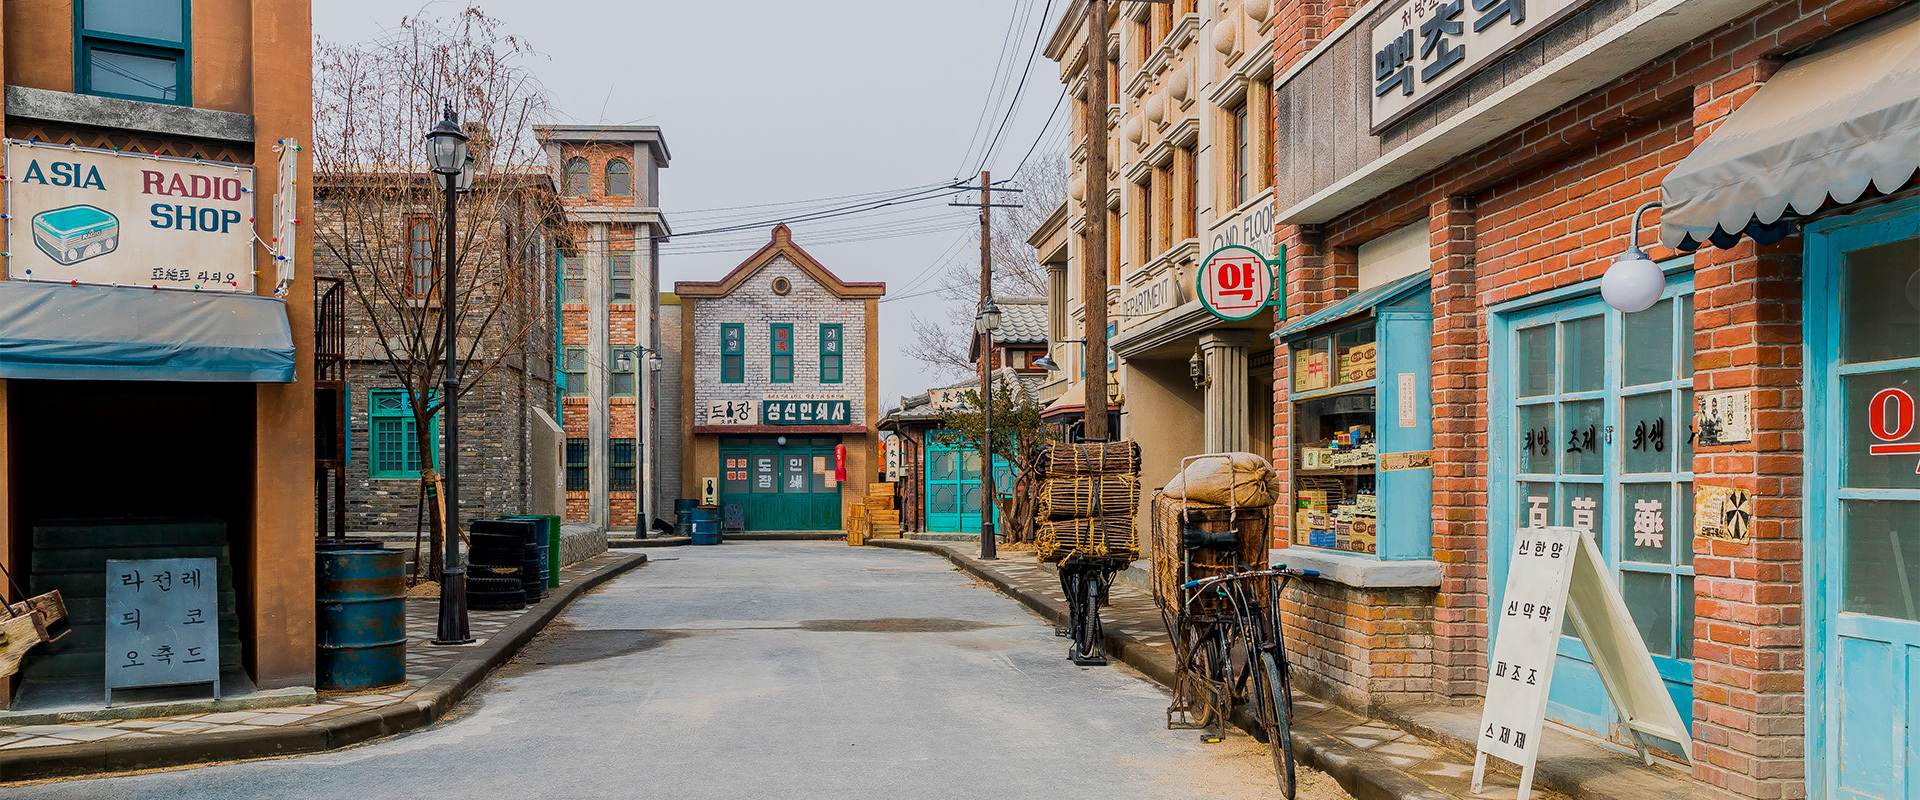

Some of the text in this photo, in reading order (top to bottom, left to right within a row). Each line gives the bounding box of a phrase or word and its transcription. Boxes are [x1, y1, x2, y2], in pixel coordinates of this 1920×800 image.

[22, 159, 107, 192] ASIA
[141, 169, 242, 201] RADIO
[149, 203, 242, 234] SHOP
[1217, 263, 1256, 301] 약
[1123, 277, 1169, 323] DEPARTMENT
[711, 400, 752, 421] 도장
[767, 402, 845, 420] 성신인쇄사
[758, 458, 772, 489] 도장
